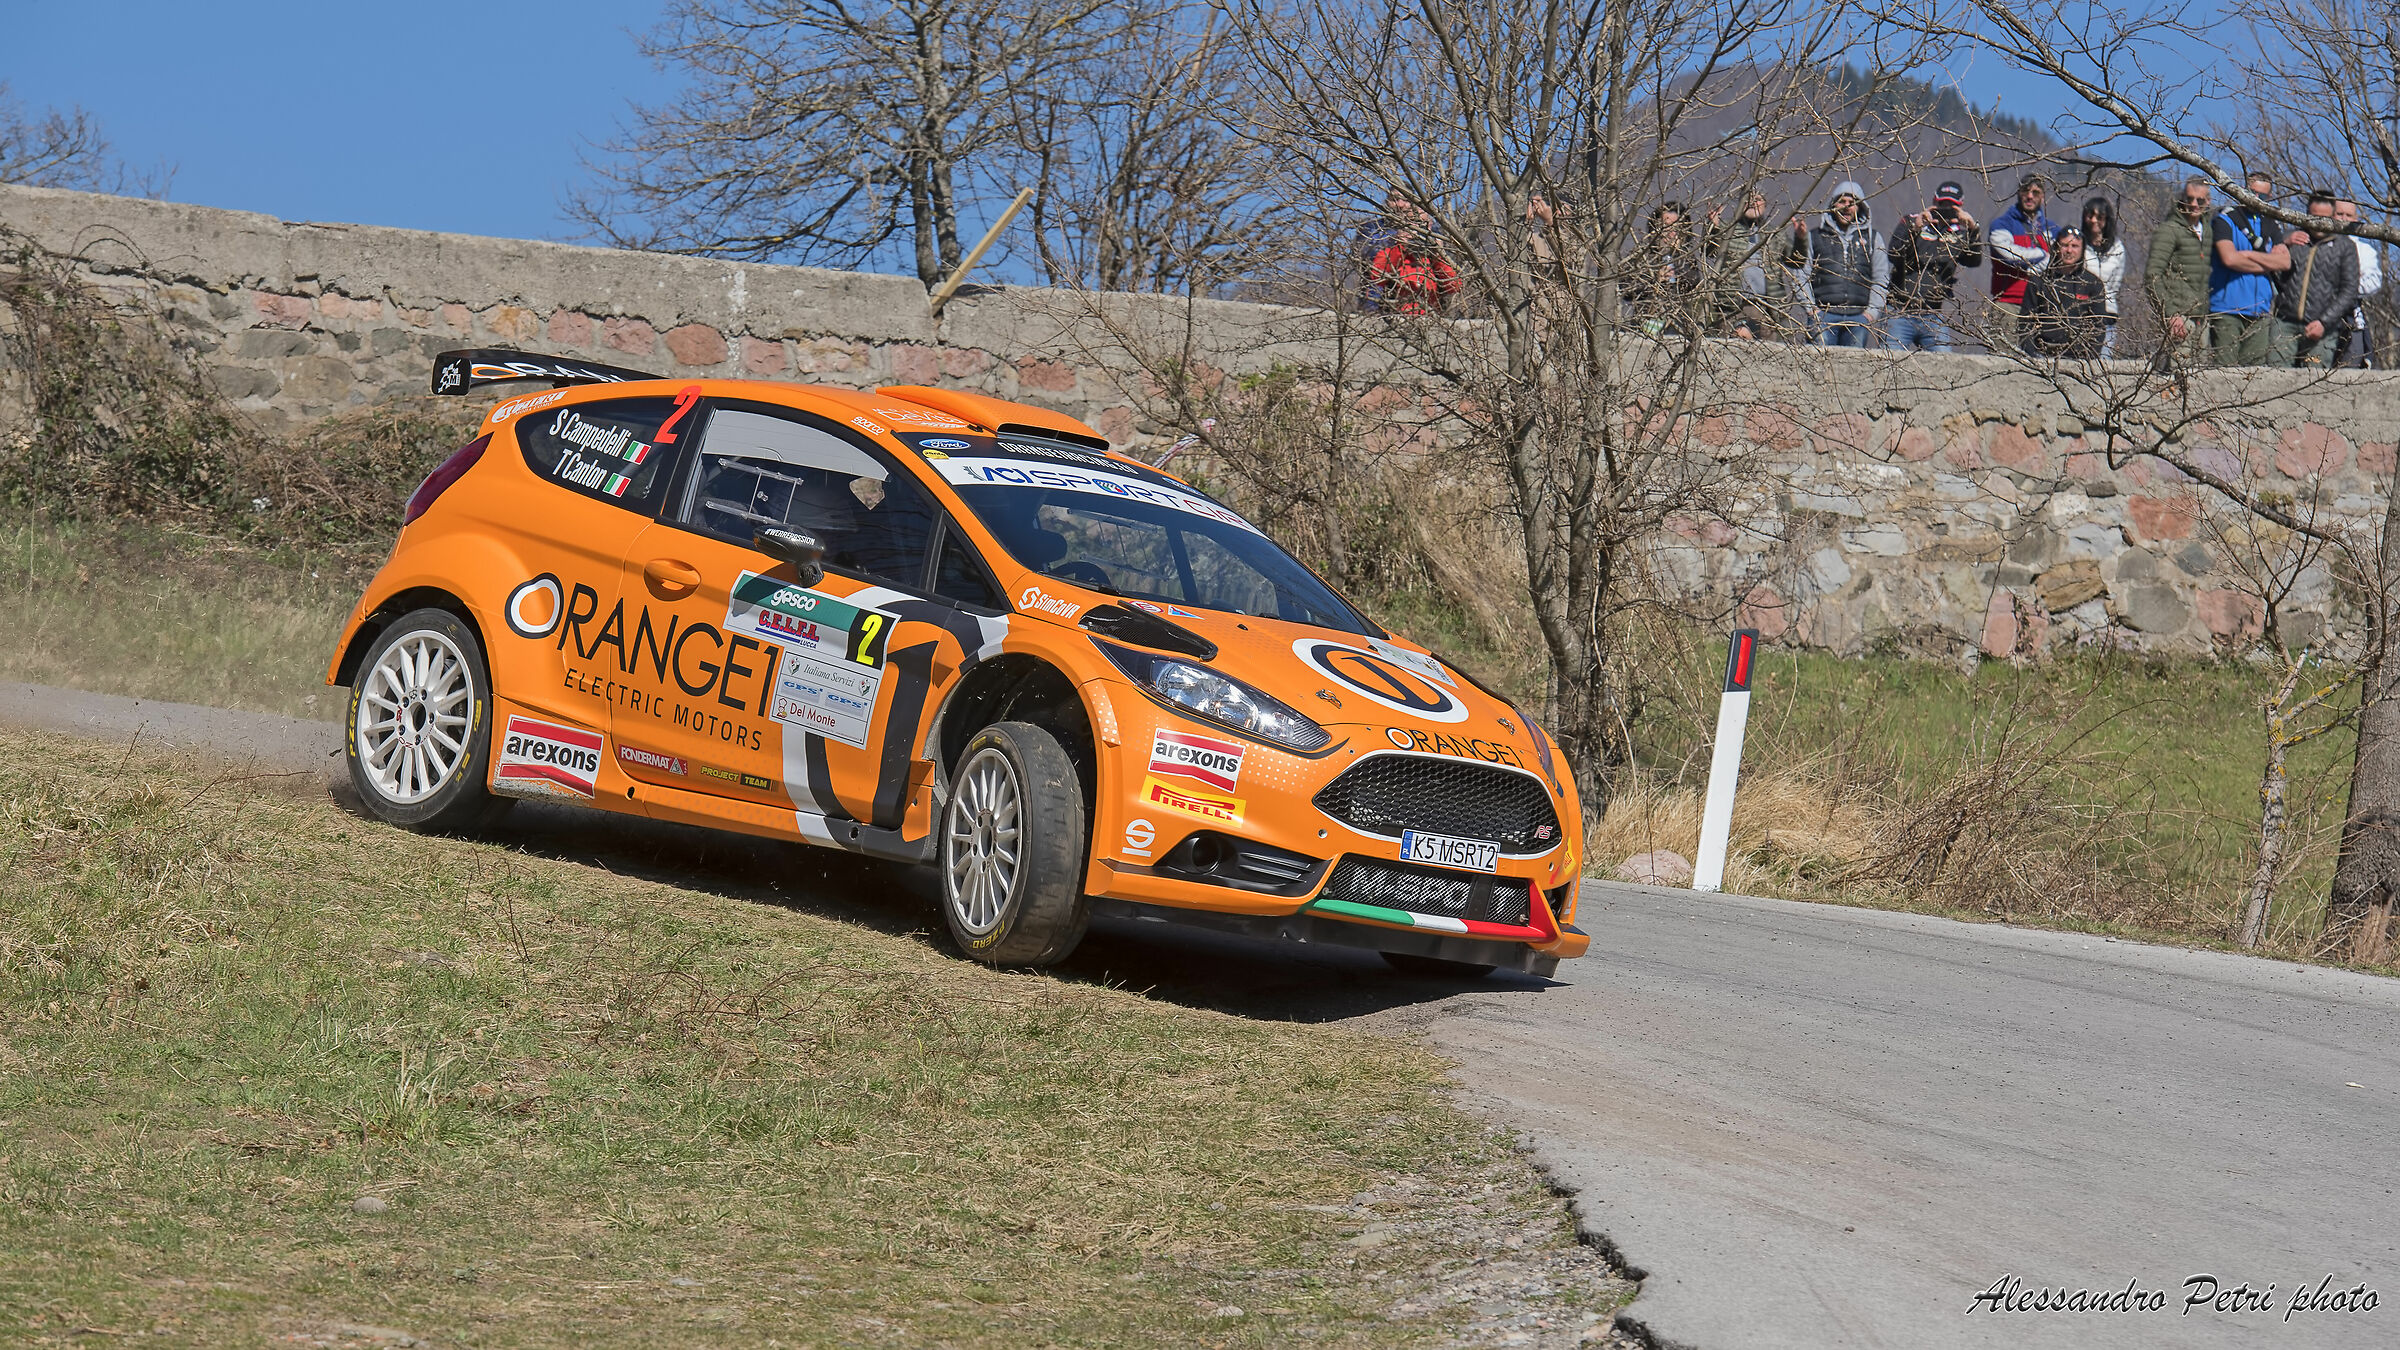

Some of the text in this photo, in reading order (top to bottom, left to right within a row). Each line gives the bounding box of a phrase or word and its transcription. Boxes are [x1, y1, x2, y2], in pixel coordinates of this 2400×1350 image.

[653, 384, 703, 444] 2
[852, 416, 885, 435] sparco
[549, 408, 569, 436] S
[560, 412, 632, 458] Campedelli
[930, 440, 963, 448] Ford
[552, 448, 608, 490] T Canton
[1034, 593, 1081, 619] SimCoVR
[757, 609, 820, 642] C.E.L.F.A.
[855, 613, 883, 666] 2
[504, 572, 779, 718] ORANGE1
[799, 637, 817, 650] LUCCA
[803, 664, 856, 688] Italiana Servizi
[563, 667, 665, 718] ELECTRIC
[673, 703, 762, 751] MOTORS
[789, 702, 837, 728] Del Monte
[506, 736, 598, 772] arexons
[620, 746, 670, 770] FONDERMAT
[1155, 741, 1239, 773] arexons
[1385, 727, 1525, 769] ORANGE1
[701, 765, 740, 782] PROJECT
[744, 776, 768, 788] TEAM
[1150, 784, 1236, 821] PIRELLI
[1533, 824, 1553, 840] RS
[1412, 834, 1496, 869] K5 MSRT2
